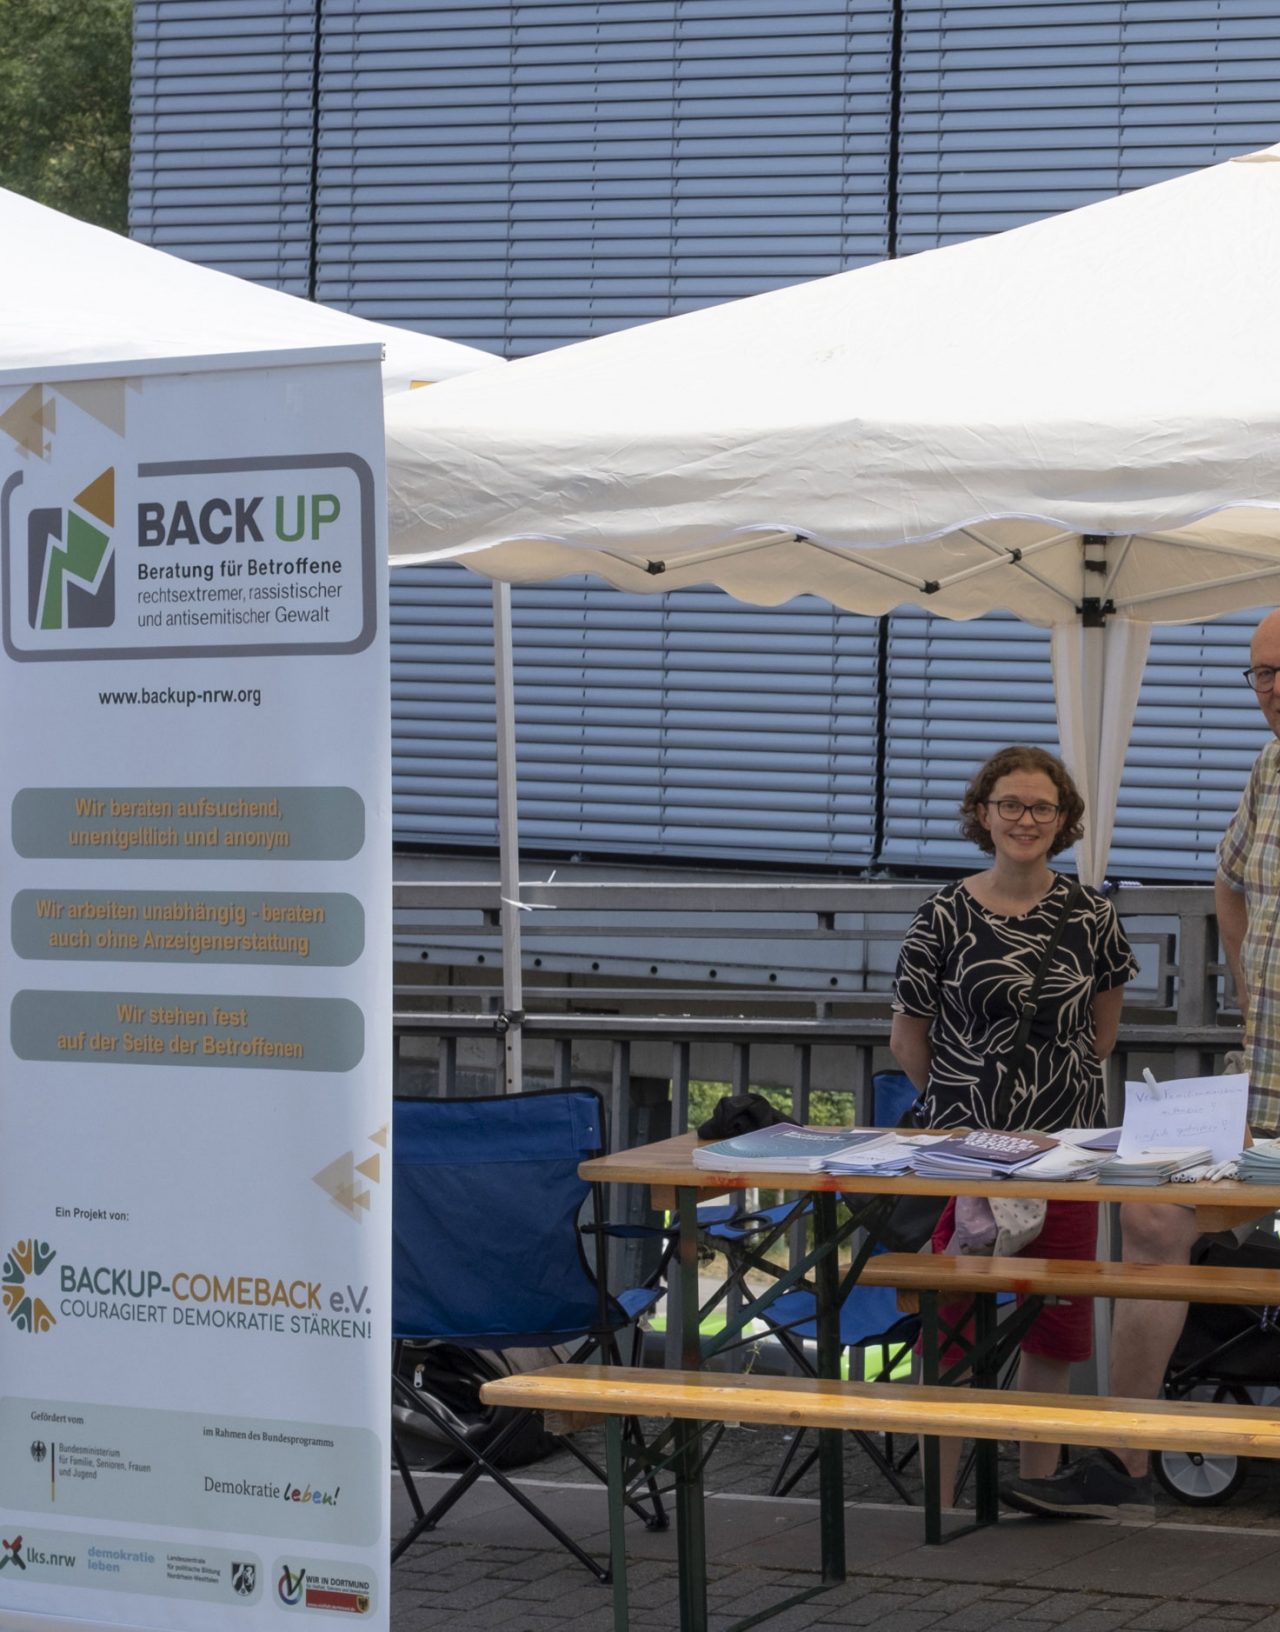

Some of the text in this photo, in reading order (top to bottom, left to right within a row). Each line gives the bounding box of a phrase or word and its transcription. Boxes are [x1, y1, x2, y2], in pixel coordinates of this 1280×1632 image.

[138, 493, 341, 547] BACK UP
[138, 558, 342, 582] Beratung für Betroffene
[138, 583, 343, 605] rechtsextremer, rassistischer
[138, 606, 330, 627] und antisemitischer Gewalt
[99, 688, 261, 706] www.backup-nrw.org
[75, 797, 283, 820] Wir beraten aufsuchend,
[68, 826, 289, 850] unentgeltlich und anonym
[36, 900, 64, 919] Wir
[67, 900, 138, 920] arbeiten
[142, 902, 246, 925] unabhängig
[261, 904, 325, 923] beraten
[49, 930, 310, 956] auch ohne Anzeigenerstattung
[116, 1004, 248, 1026] Wir stehen fest
[57, 1032, 304, 1058] auf der Seite der Betroffenen
[55, 1206, 129, 1221] Ein Projekt von:
[60, 1265, 372, 1314] BACKUP-COMEBACK e.V.
[60, 1299, 372, 1339] COURAGIERT DEMOKRATIE STÄRKEN!
[31, 1411, 84, 1424] Gefördert vom
[203, 1427, 334, 1447] im Rahmen des Bundesprogramms
[59, 1443, 120, 1457] Bundesministerium
[59, 1467, 97, 1480] und Jugend
[128, 1462, 151, 1472] Frauen
[204, 1476, 280, 1498] Demokratie
[27, 1547, 76, 1567] lks.nrw
[88, 1547, 155, 1563] demokratie
[88, 1560, 120, 1572] leben
[306, 1575, 320, 1584] WIR
[321, 1577, 329, 1585] IN
[331, 1578, 370, 1589] DORTMUND
